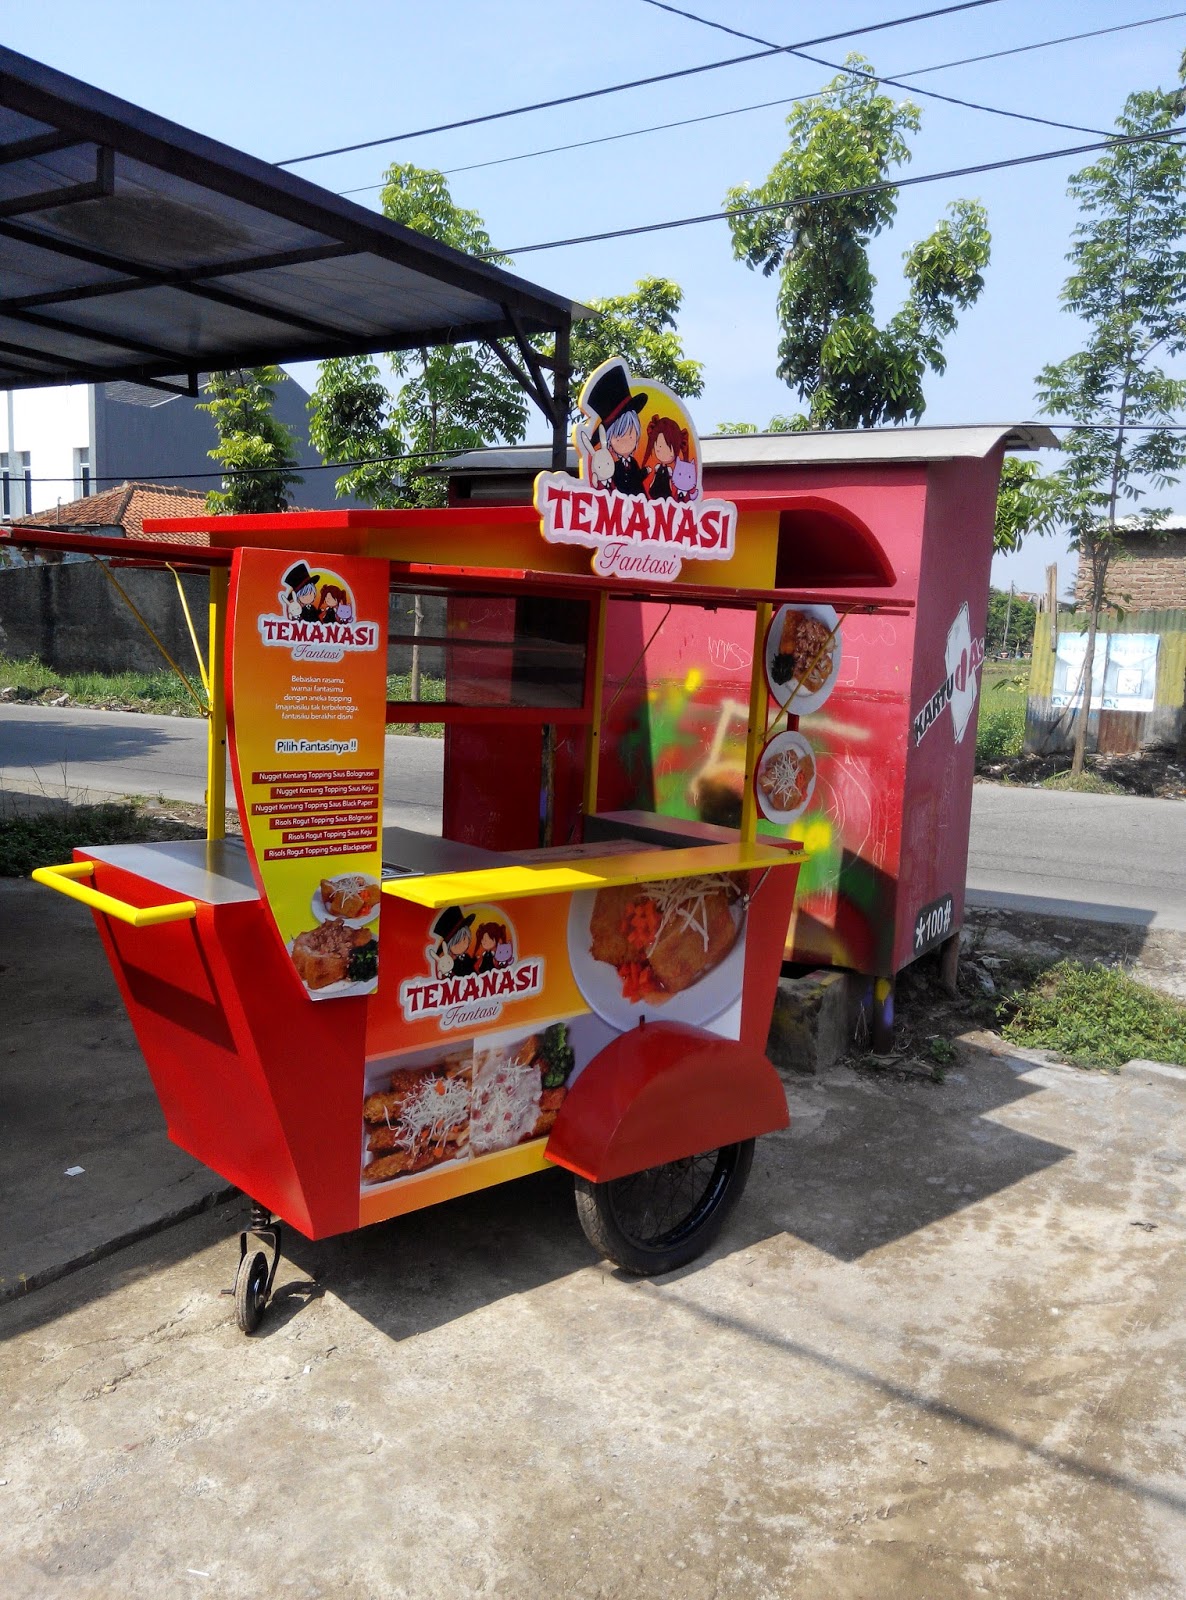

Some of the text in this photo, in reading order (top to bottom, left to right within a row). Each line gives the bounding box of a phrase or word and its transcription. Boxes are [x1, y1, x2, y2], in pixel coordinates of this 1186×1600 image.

[547, 486, 731, 549] TEMANASI
[599, 542, 678, 574] Fantasi
[263, 620, 374, 646] TEMANASI
[294, 644, 341, 660] Fantasi
[291, 675, 321, 684] Bebaskan
[313, 685, 344, 693] fantasimu
[284, 694, 308, 703] dengan
[327, 695, 352, 704] topping
[275, 703, 310, 712] Imajinasiku
[914, 673, 954, 743] KARTU
[277, 740, 298, 752] Pilih
[300, 741, 349, 754] Fantasinya
[259, 773, 281, 781] Nugget
[283, 772, 307, 780] Kentang
[308, 771, 332, 779] Topping
[276, 788, 298, 796] Nugget
[299, 787, 323, 795] Kentang
[324, 786, 347, 794] Topping
[255, 804, 278, 812] Nugget
[279, 803, 303, 811] Kentang
[304, 802, 328, 810] Topping
[324, 831, 346, 839] Topping
[407, 965, 538, 1012] TEMANASI
[444, 1001, 499, 1026] Fantasi
